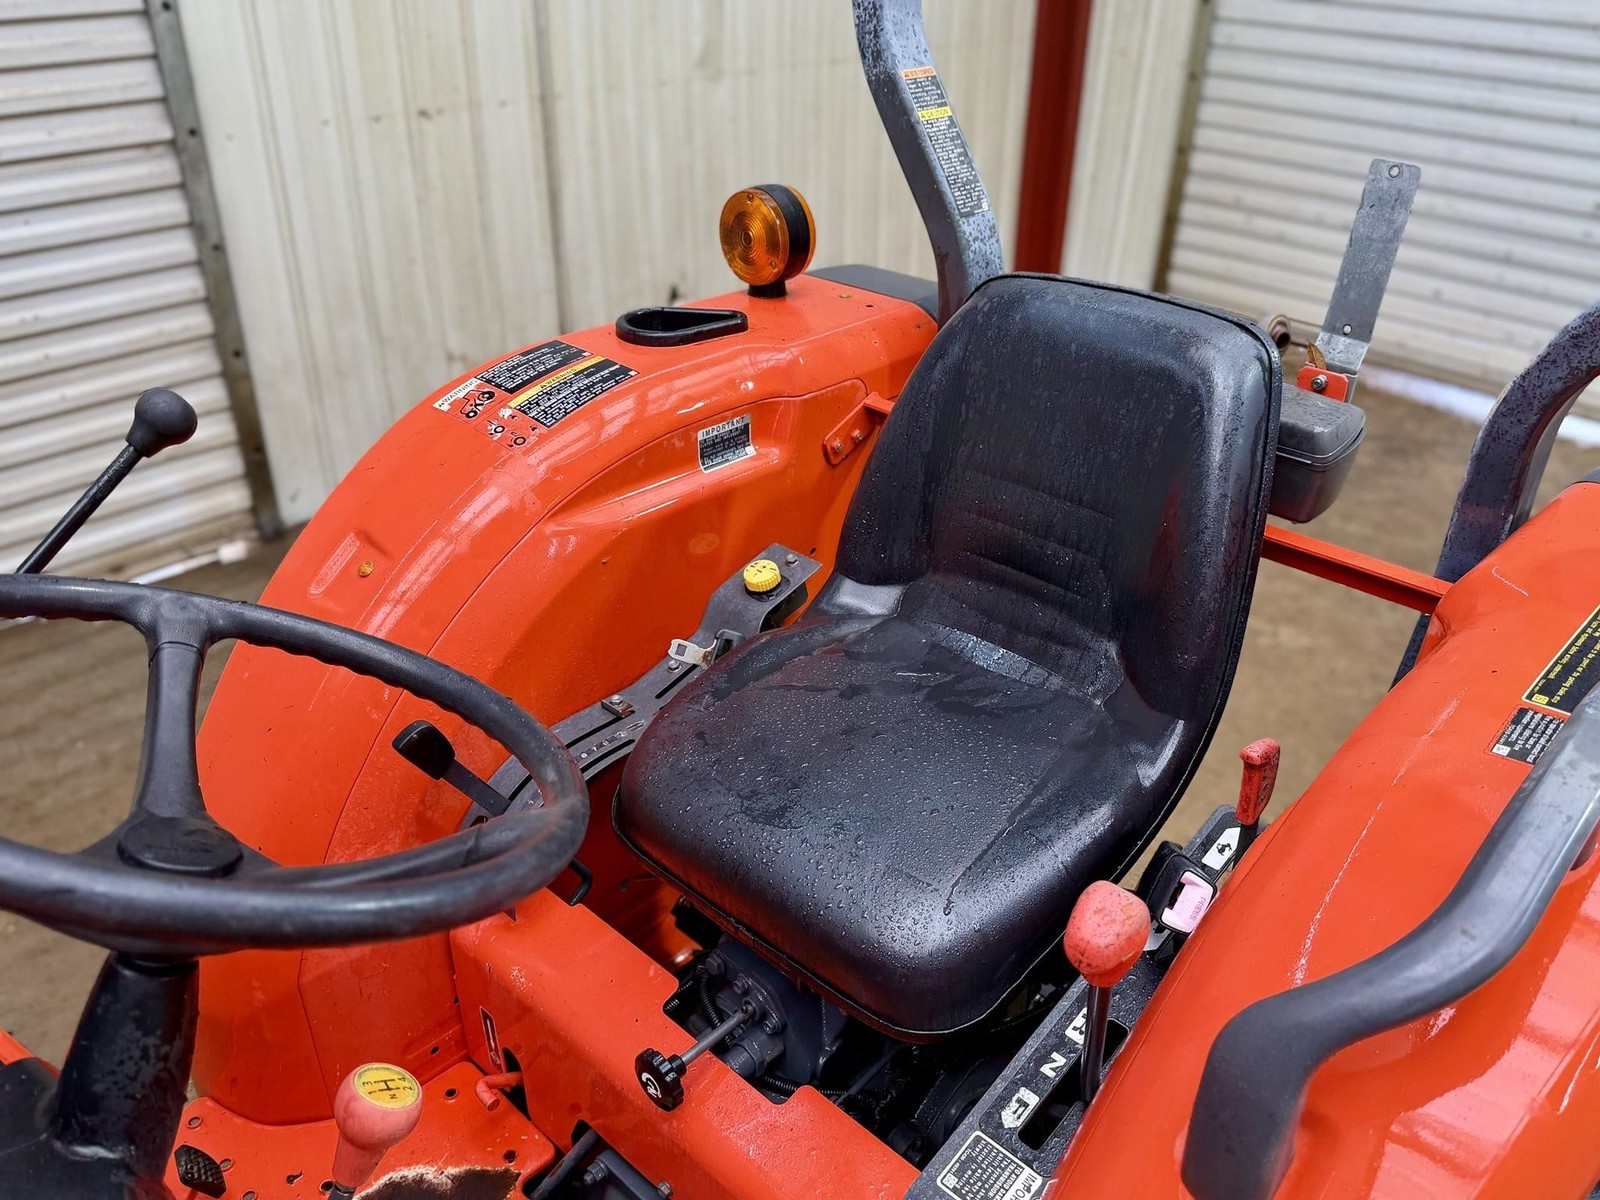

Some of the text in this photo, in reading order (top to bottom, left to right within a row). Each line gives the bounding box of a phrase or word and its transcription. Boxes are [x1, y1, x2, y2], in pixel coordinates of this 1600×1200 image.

[546, 368, 577, 386] WARNING
[442, 379, 478, 402] WARNING
[702, 416, 744, 438] IMPORTANT
[1190, 896, 1206, 921] PRESS
[1040, 1052, 1067, 1078] N
[1012, 1096, 1030, 1120] F
[969, 1139, 985, 1157] slowly.
[976, 1144, 991, 1162] tractor
[992, 1152, 1004, 1166] shift
[1000, 1157, 1010, 1168] The
[955, 1169, 971, 1188] moving
[961, 1148, 997, 1194] shifted while the
[980, 1166, 994, 1180] lever
[983, 1167, 1001, 1188] synchro
[1014, 1166, 1022, 1174] TO
[971, 1180, 981, 1192] may
[987, 1162, 1015, 1197] TRANSMISSION:
[1003, 1173, 1016, 1189] AVOID
